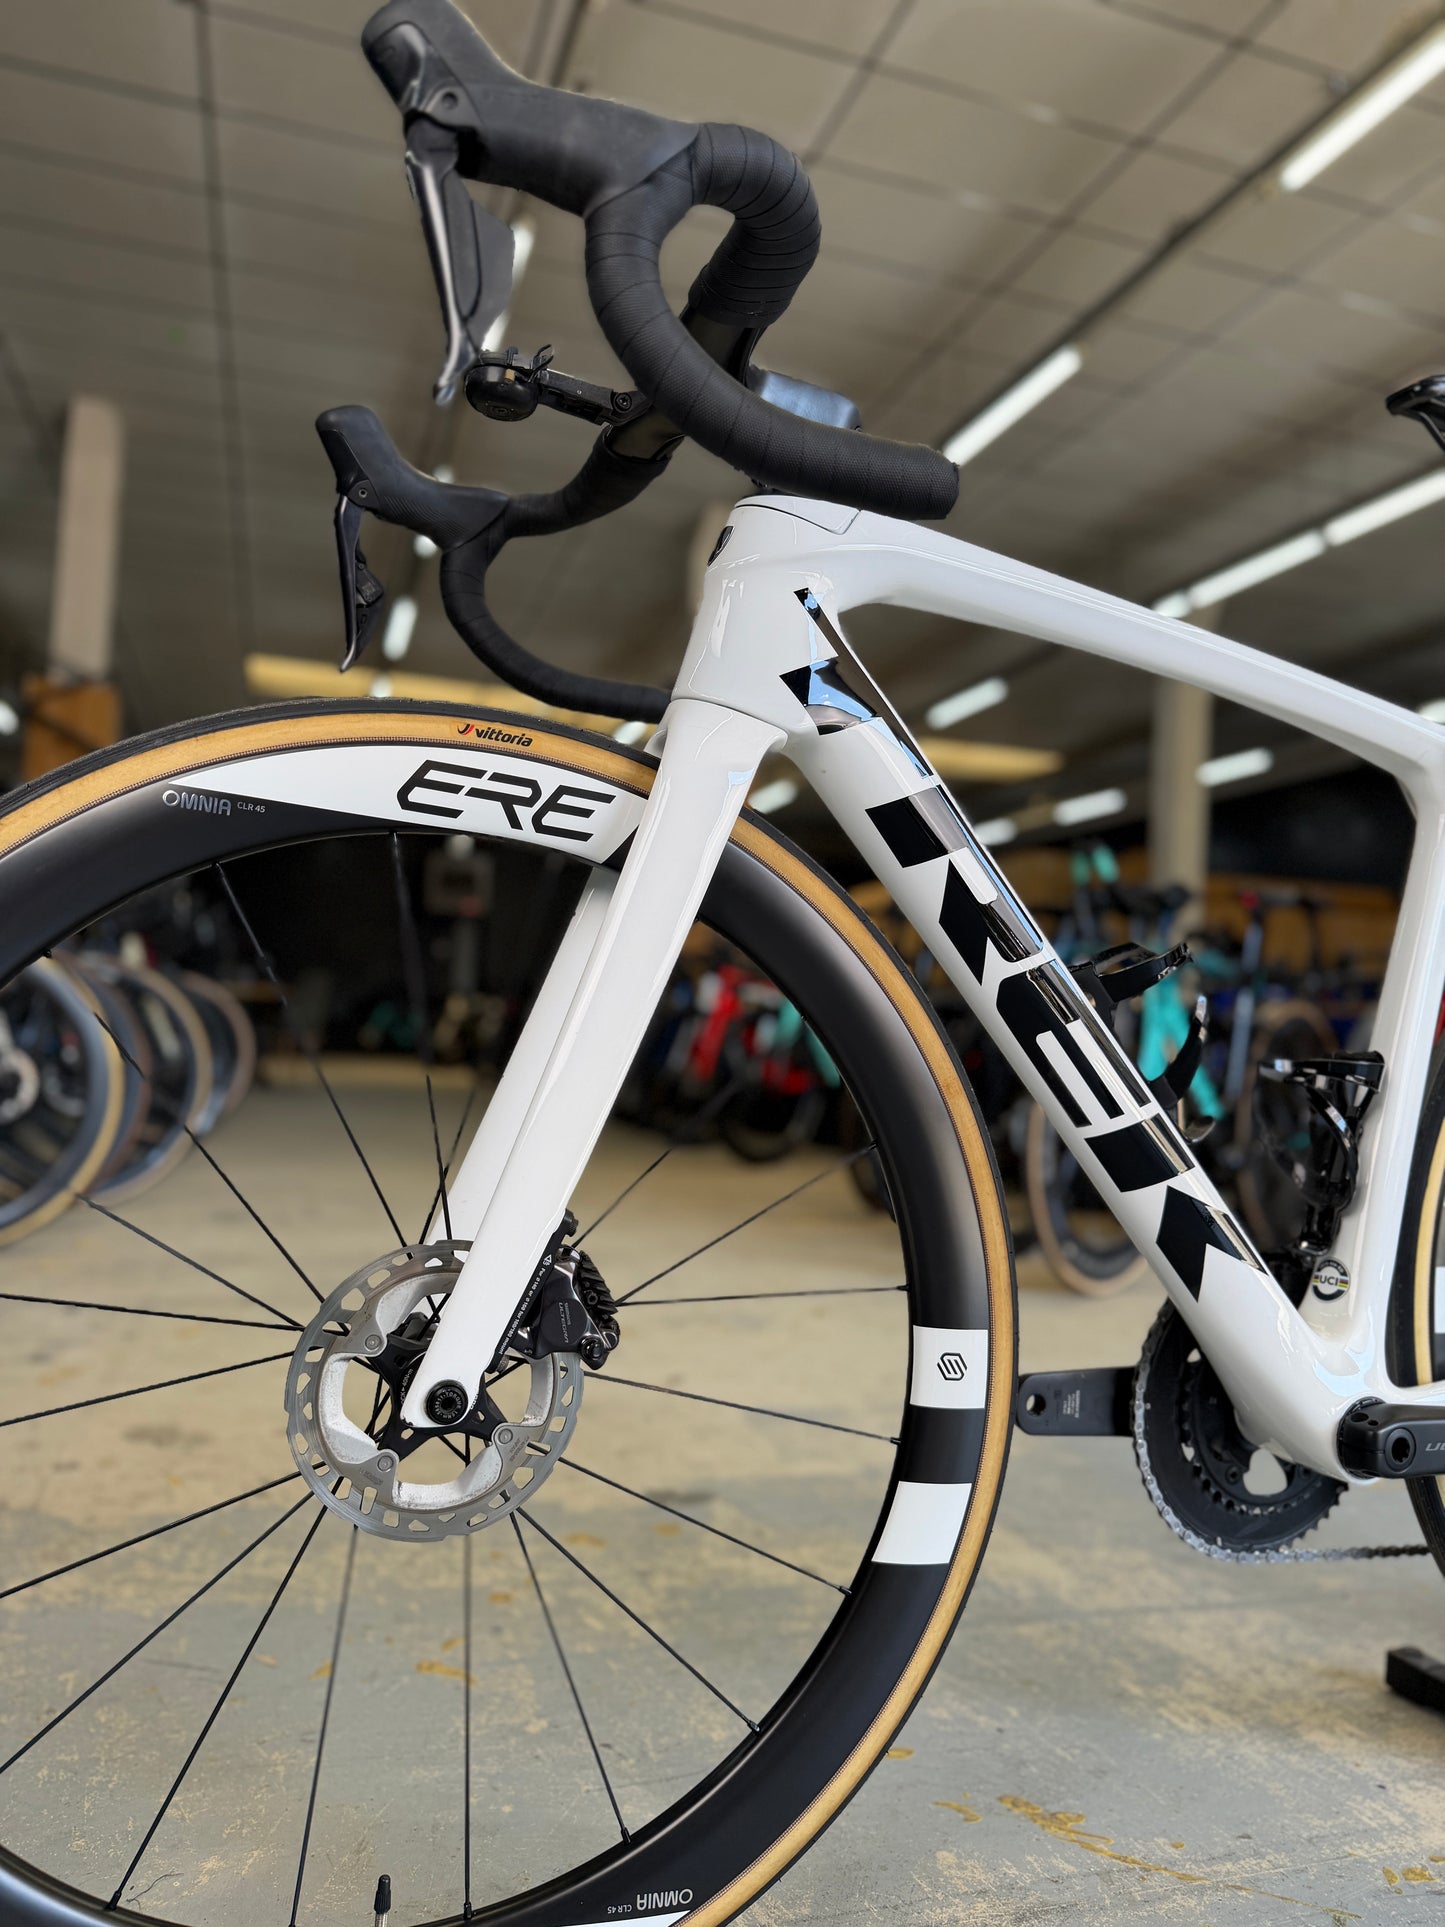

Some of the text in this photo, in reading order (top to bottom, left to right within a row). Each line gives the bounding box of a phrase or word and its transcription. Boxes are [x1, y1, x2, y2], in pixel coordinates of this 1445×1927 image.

[475, 726, 533, 747] vittoria
[162, 789, 266, 816] OMNIA CLR 45
[396, 758, 616, 843] ERE
[778, 587, 1268, 1302] TREK
[1319, 1274, 1339, 1287] UCI
[499, 1337, 510, 1354] mount
[607, 1888, 693, 1914] OMNIA CLR 45
